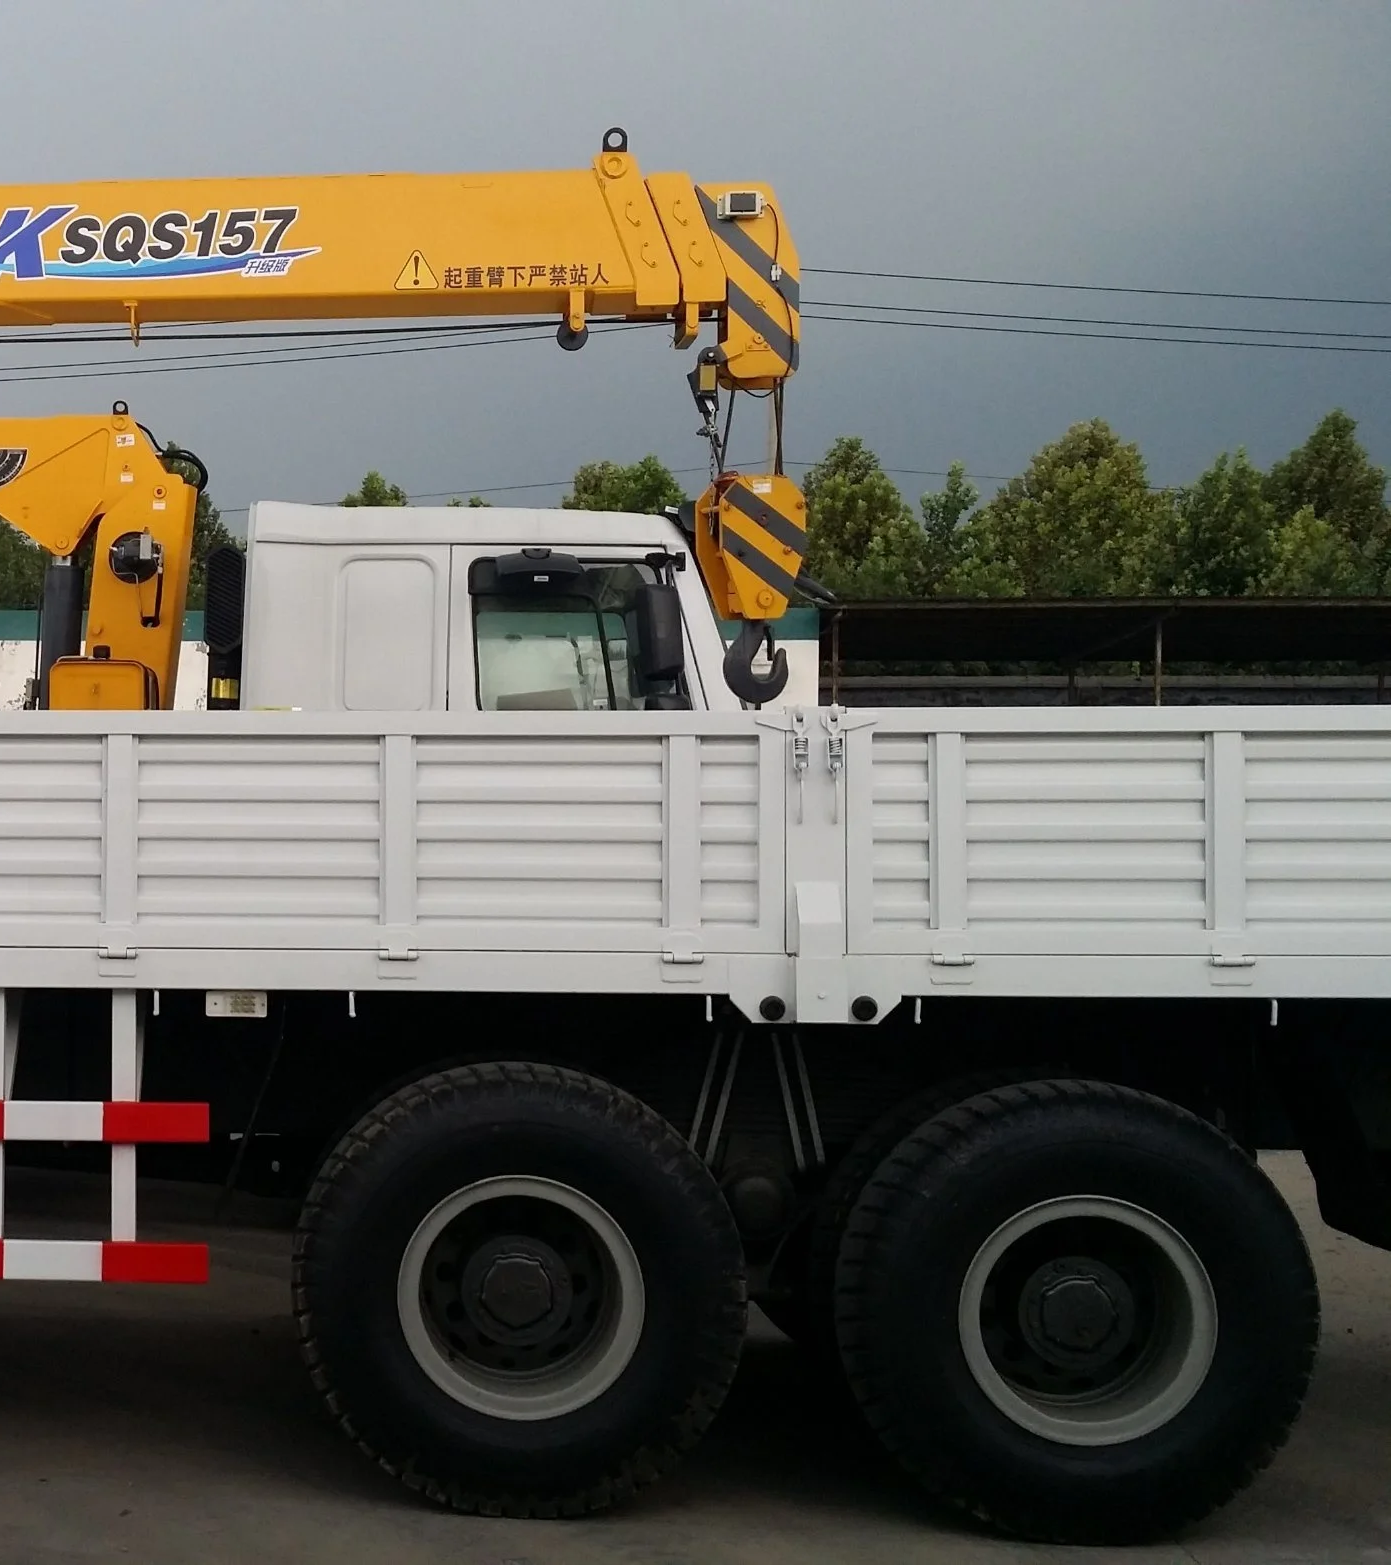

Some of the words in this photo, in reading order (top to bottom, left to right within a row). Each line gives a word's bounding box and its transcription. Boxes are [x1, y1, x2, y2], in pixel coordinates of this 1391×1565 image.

[244, 258, 290, 274] 升级版
[443, 262, 610, 289] 起重臂下严禁站人
